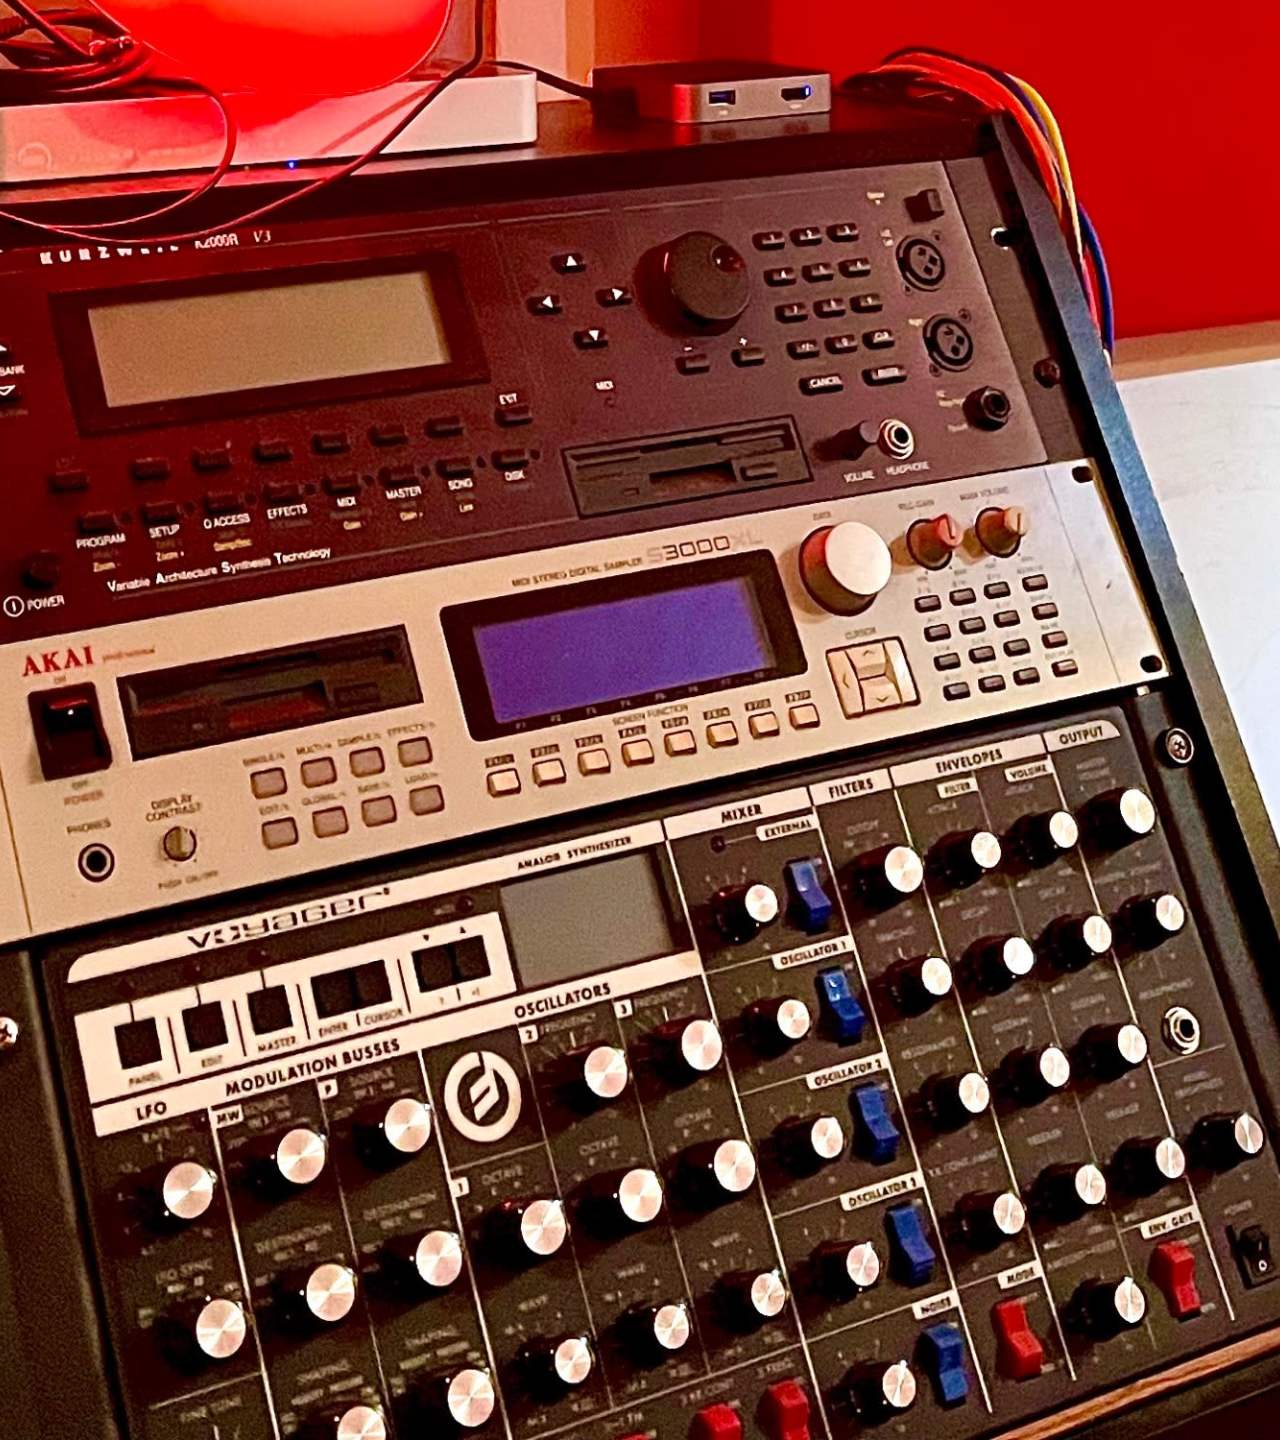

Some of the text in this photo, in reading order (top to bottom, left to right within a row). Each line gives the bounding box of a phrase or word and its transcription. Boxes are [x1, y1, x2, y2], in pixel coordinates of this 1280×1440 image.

[448, 478, 473, 491] SONG
[843, 469, 875, 483] VOLUME
[386, 485, 422, 500] MASTER
[214, 513, 251, 528] ACCESS
[267, 503, 308, 520] EFFECTS
[76, 533, 126, 550] PROGRAM
[149, 524, 180, 539] SETUP
[107, 546, 331, 593] Variable Architecture Synthesis Technology
[532, 570, 567, 585] STEREO
[569, 564, 601, 579] DIGITAL
[27, 594, 65, 610] POWER
[22, 646, 95, 677] AKAI
[1059, 725, 1104, 745] OUTPUT
[936, 748, 1003, 774] ENVELOPES
[828, 777, 874, 800] FILTERS
[145, 801, 203, 823] CONTRAST
[151, 794, 194, 810] DISPLAY
[720, 803, 763, 824] MIXER
[764, 818, 812, 839] EXTERNAL
[567, 836, 633, 860] SYNTHESIZER
[780, 942, 839, 966] OSCILLATOR
[514, 982, 612, 1019] OSCILLATORS
[363, 1008, 404, 1026] CURSOR
[257, 1035, 297, 1053] MASTER
[225, 1038, 401, 1097] MODULATION BUSSES
[814, 1063, 873, 1087] OSCILLATOR
[136, 1101, 167, 1121] LFO
[848, 1180, 908, 1208] OSCILLATOR
